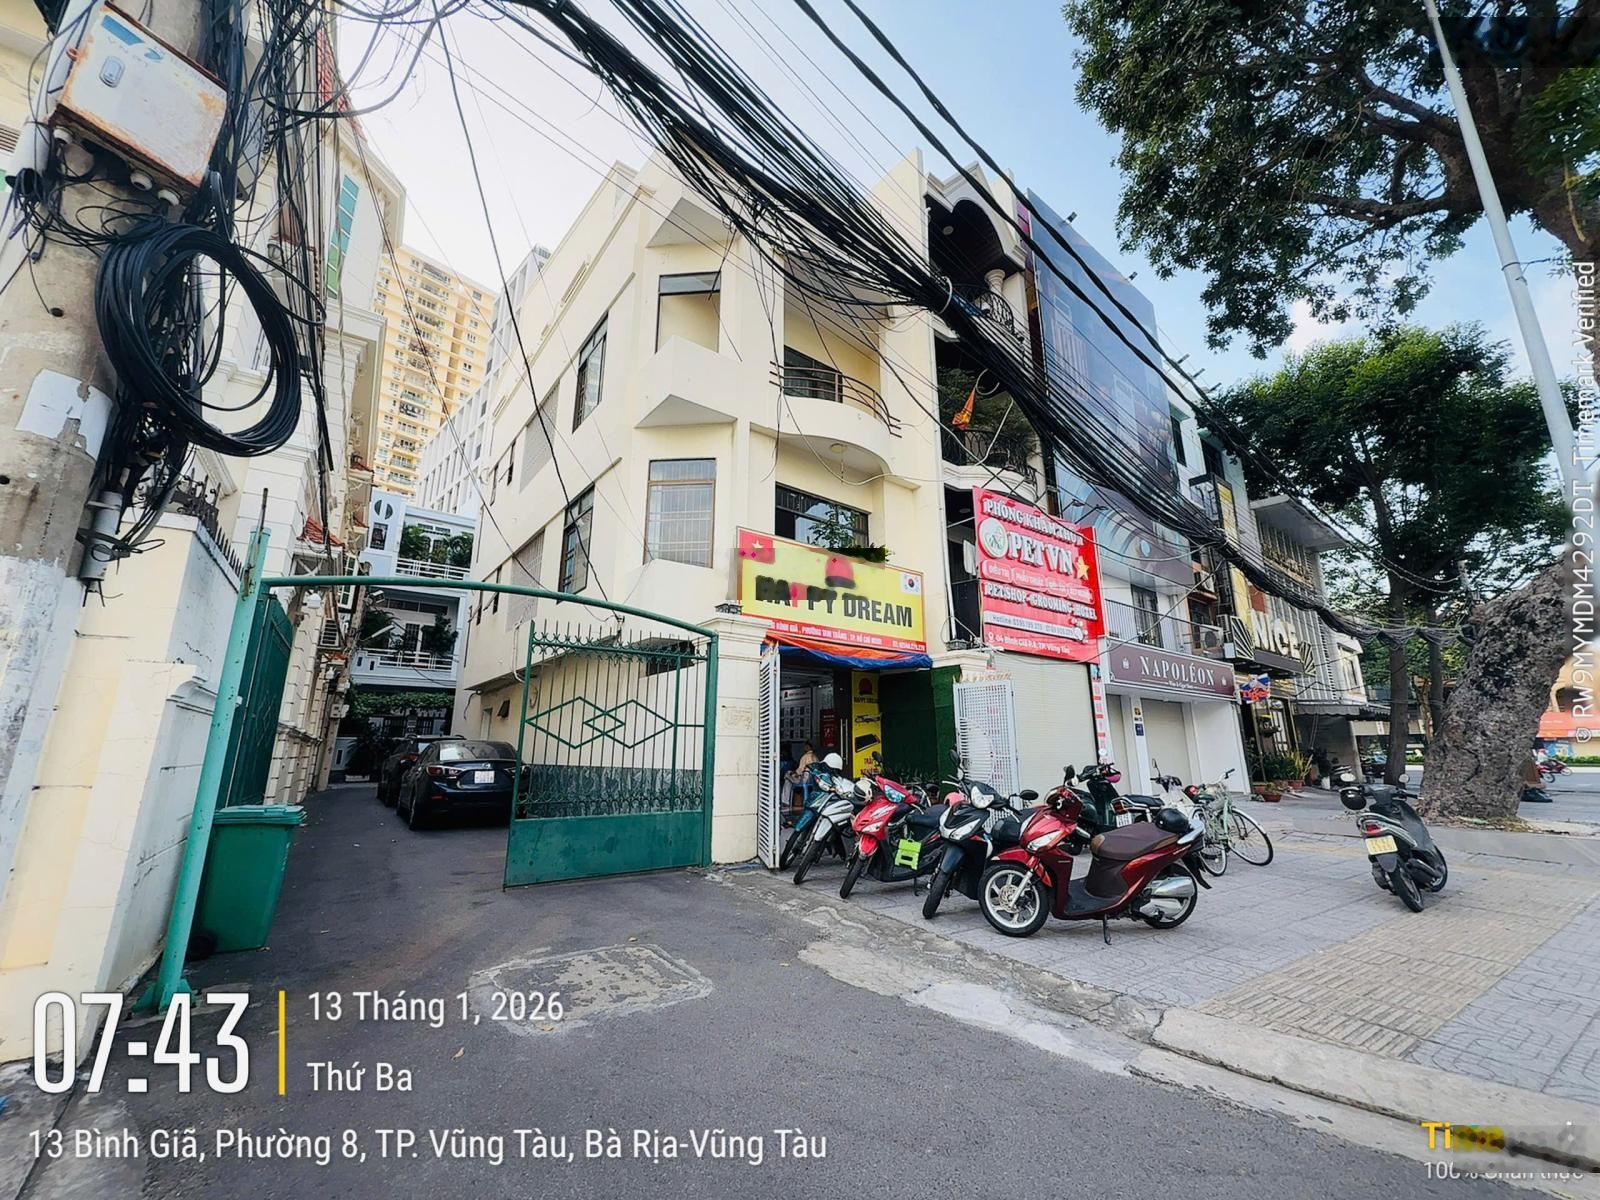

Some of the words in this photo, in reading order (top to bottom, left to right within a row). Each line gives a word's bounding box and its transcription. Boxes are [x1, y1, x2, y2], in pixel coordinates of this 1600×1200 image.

[842, 592, 913, 628] DREAM
[1251, 608, 1301, 661] NICE
[1139, 656, 1215, 686] NAPOLÉON
